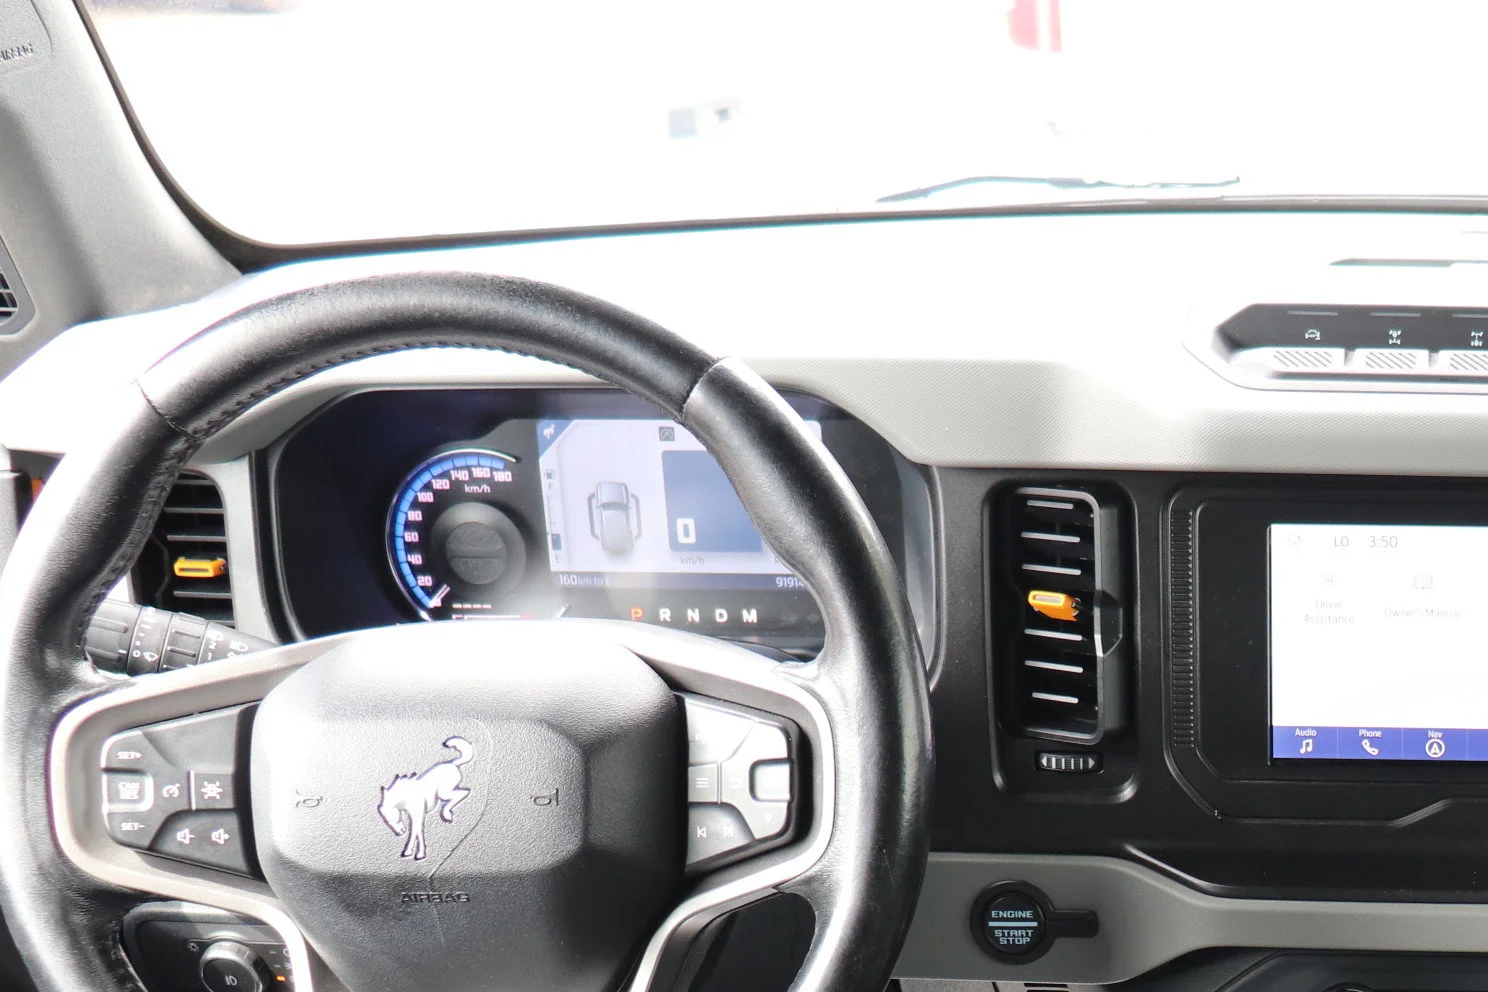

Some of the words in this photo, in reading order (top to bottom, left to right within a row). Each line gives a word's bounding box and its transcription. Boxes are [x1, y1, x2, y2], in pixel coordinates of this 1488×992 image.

[449, 470, 469, 481] 140
[471, 467, 491, 478] 160
[493, 470, 512, 482] 180
[431, 478, 450, 490] 120
[464, 484, 491, 493] km/h
[417, 491, 434, 503] 100
[407, 510, 422, 521] 80
[676, 517, 697, 544] 0
[404, 531, 419, 543] 60
[1368, 535, 1399, 548] 3:50
[407, 554, 422, 565] 40
[680, 555, 704, 565] km/h
[417, 575, 432, 587] 20
[559, 574, 577, 586] 160
[577, 575, 592, 586] km
[1315, 599, 1344, 611] Driver
[631, 607, 644, 621] P
[659, 608, 671, 622] R
[687, 608, 700, 622] N
[715, 609, 728, 623] D
[742, 609, 757, 623] M
[1295, 728, 1317, 737] Audio
[1359, 729, 1382, 738] Phone
[1428, 731, 1442, 739] Nav
[401, 891, 470, 903] AIRBAG
[991, 910, 1034, 918] ENGINE
[994, 929, 1034, 937] START
[999, 937, 1031, 945] STOP
